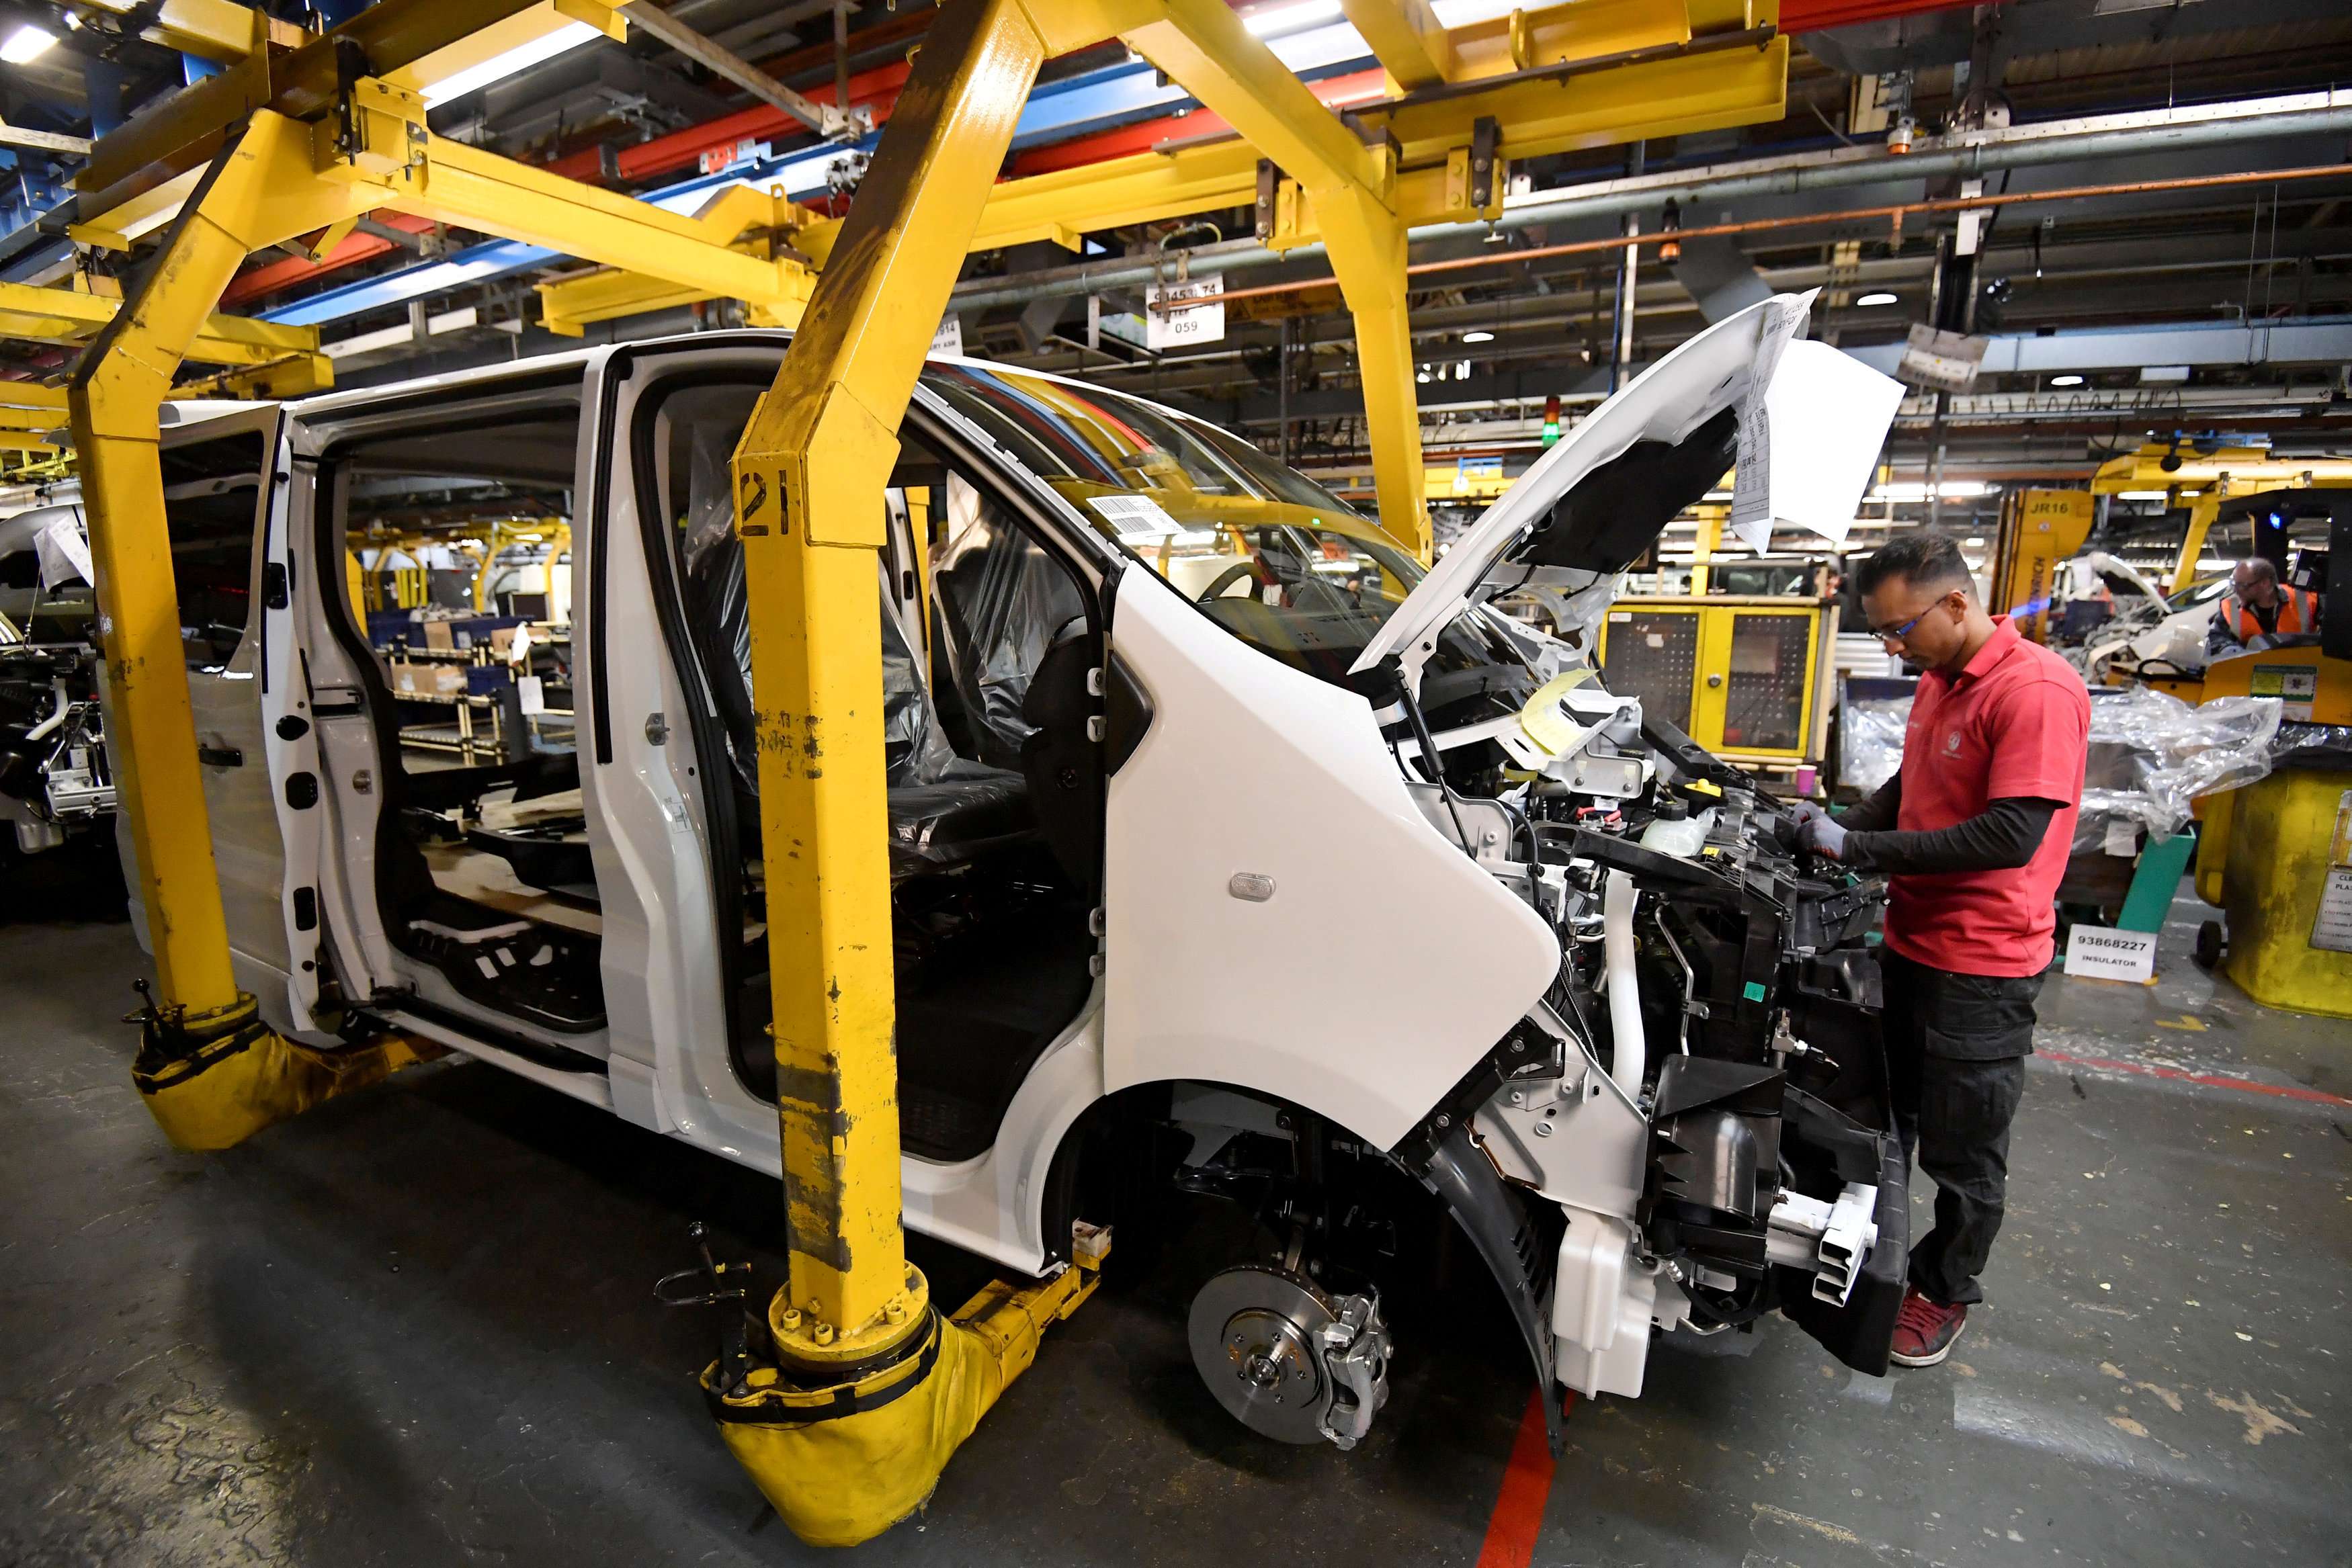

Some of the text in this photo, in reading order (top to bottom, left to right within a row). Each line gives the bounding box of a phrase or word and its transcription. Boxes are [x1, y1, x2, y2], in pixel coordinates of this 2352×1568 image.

[1175, 321, 1198, 334] 059
[741, 470, 789, 536] 21
[2030, 503, 2068, 515] JR16
[2078, 935, 2147, 951] 93868227
[2082, 955, 2136, 967] INSULATOR
